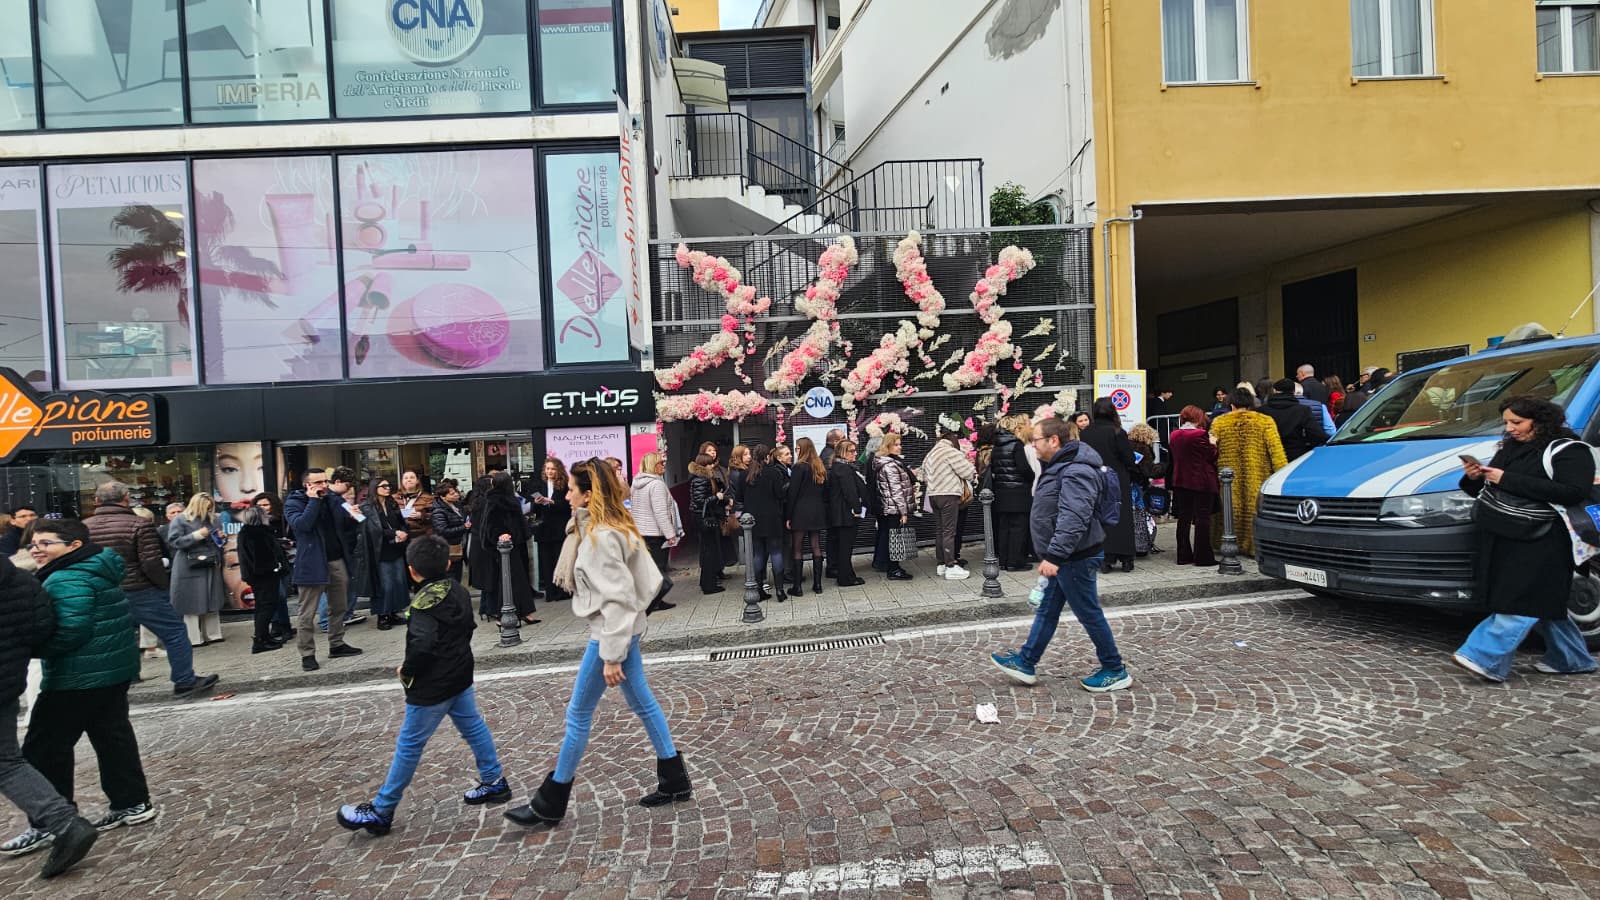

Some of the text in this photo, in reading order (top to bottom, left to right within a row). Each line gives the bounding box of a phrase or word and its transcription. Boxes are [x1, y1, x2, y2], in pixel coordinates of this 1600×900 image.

[392, 0, 475, 30] CNA
[542, 22, 609, 33] www.im.cna.it
[355, 66, 509, 83] Confederazione Nazionale
[216, 82, 321, 104] IMPERIA
[479, 79, 521, 91] Piccola
[55, 174, 183, 200] PETALICIOUS
[598, 165, 612, 228] profumerie
[806, 396, 832, 409] CNA
[72, 425, 152, 445] profumerie
